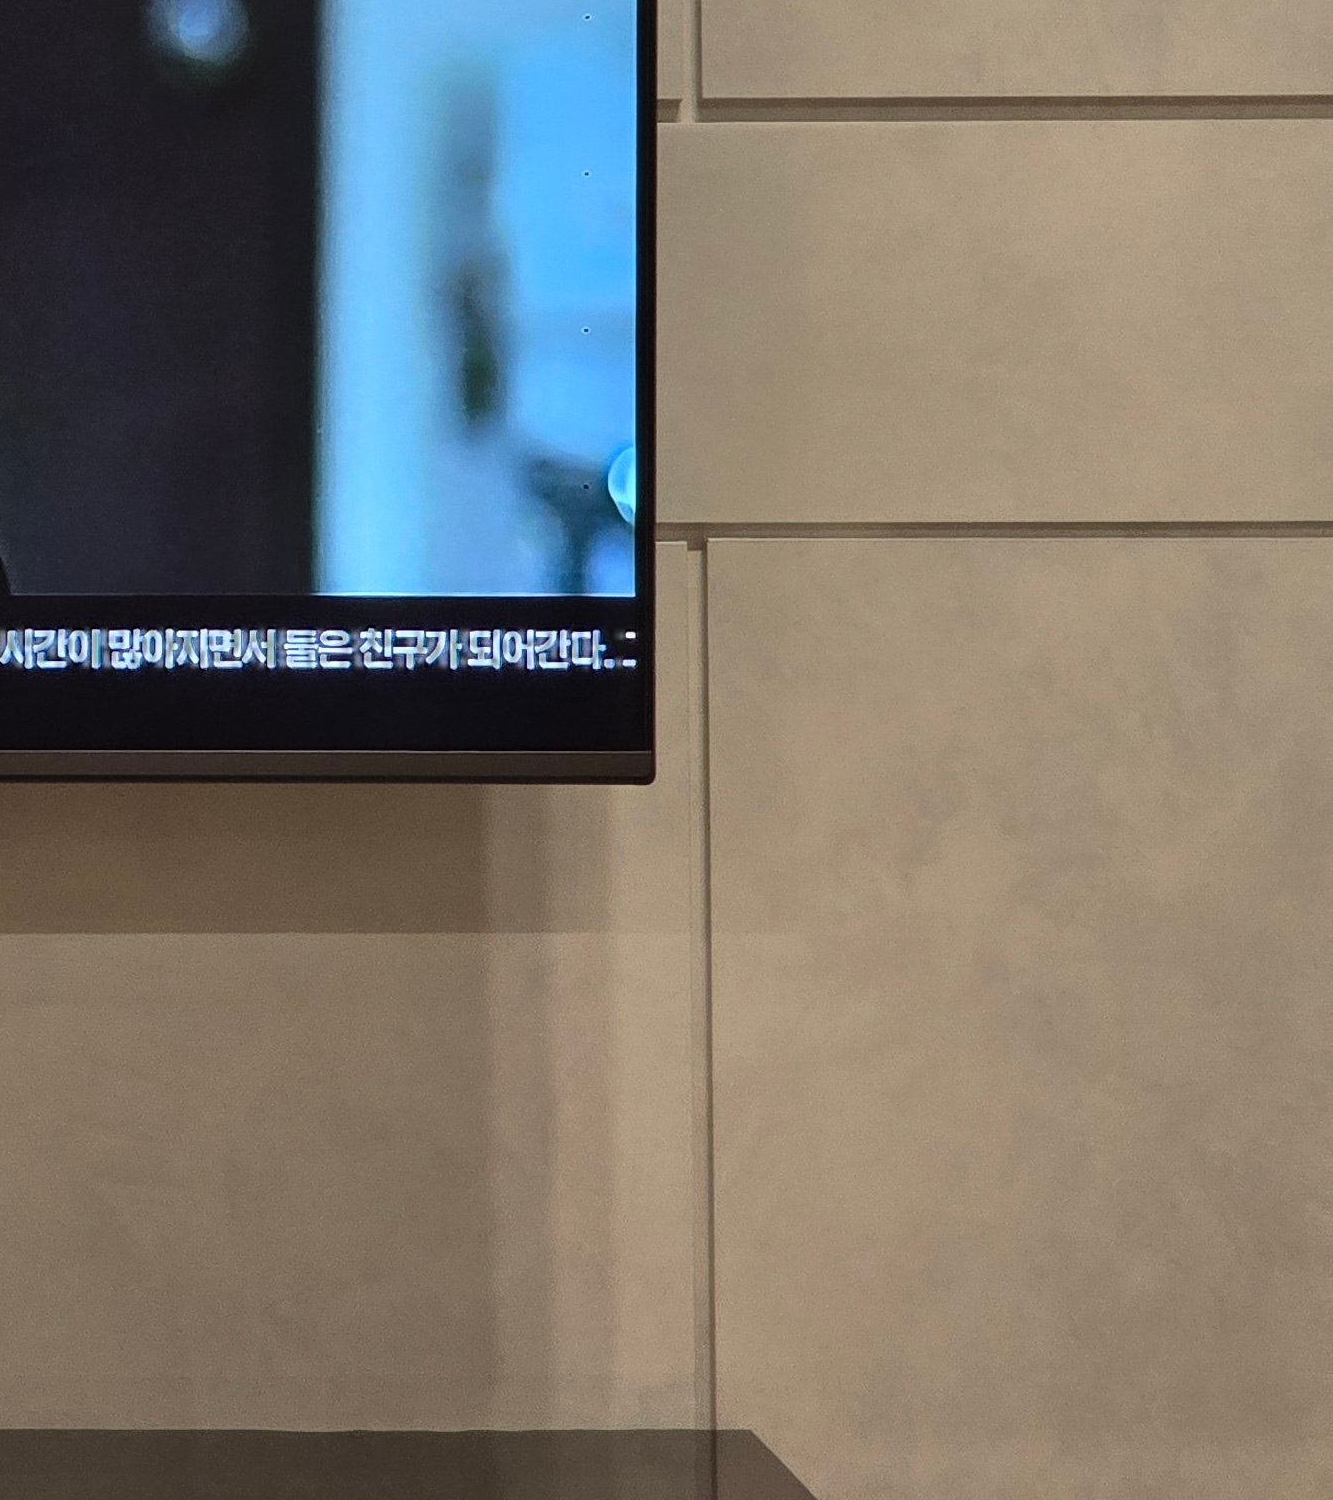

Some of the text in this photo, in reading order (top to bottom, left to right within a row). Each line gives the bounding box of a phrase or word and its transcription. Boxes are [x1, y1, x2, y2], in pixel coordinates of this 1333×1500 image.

[0, 629, 102, 669] 시간이
[108, 629, 275, 669] 많아지면서
[284, 629, 352, 669] 둘은
[359, 629, 460, 669] 친구가
[467, 629, 615, 669] 되어간다.
